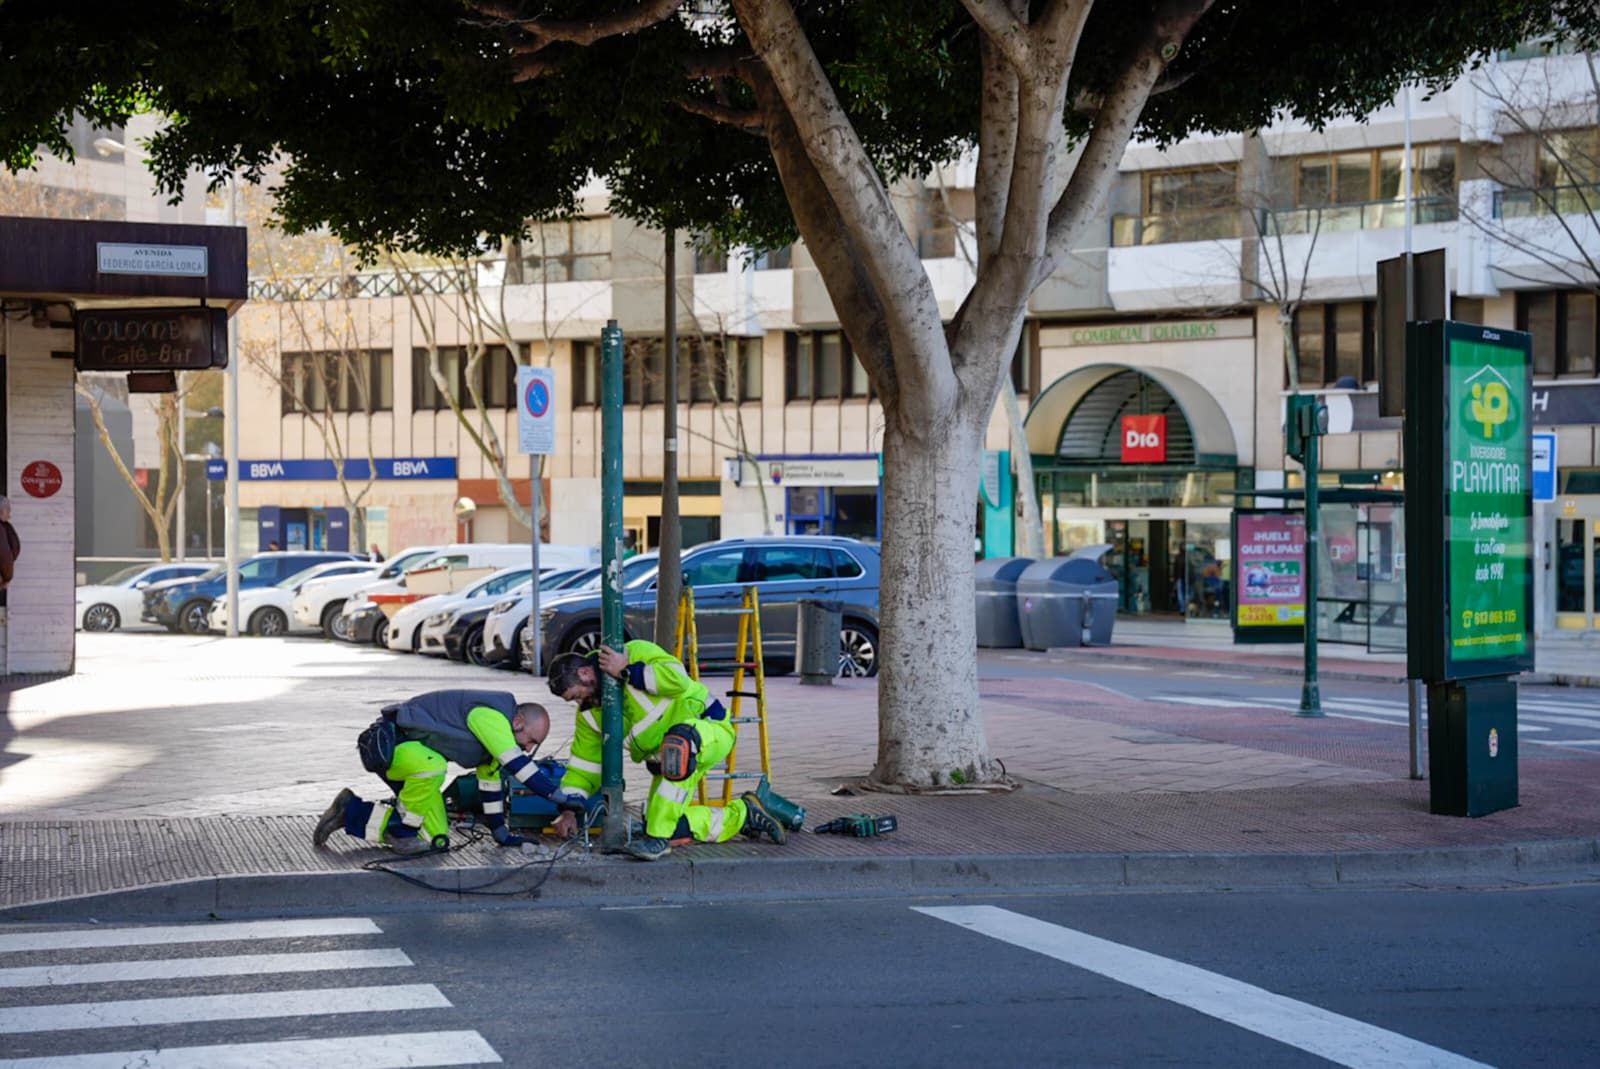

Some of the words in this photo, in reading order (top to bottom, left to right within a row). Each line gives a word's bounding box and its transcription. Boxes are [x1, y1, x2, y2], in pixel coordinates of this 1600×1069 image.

[103, 258, 143, 269] FEDERICO
[176, 261, 202, 271] LORCA
[1073, 327, 1143, 343] COMERCIAL
[1153, 323, 1216, 339] OLIVEROS
[250, 463, 284, 478] BBVA
[393, 460, 429, 476] BBVA
[1453, 460, 1521, 495] PLAYMAR
[1241, 544, 1265, 554] QUE
